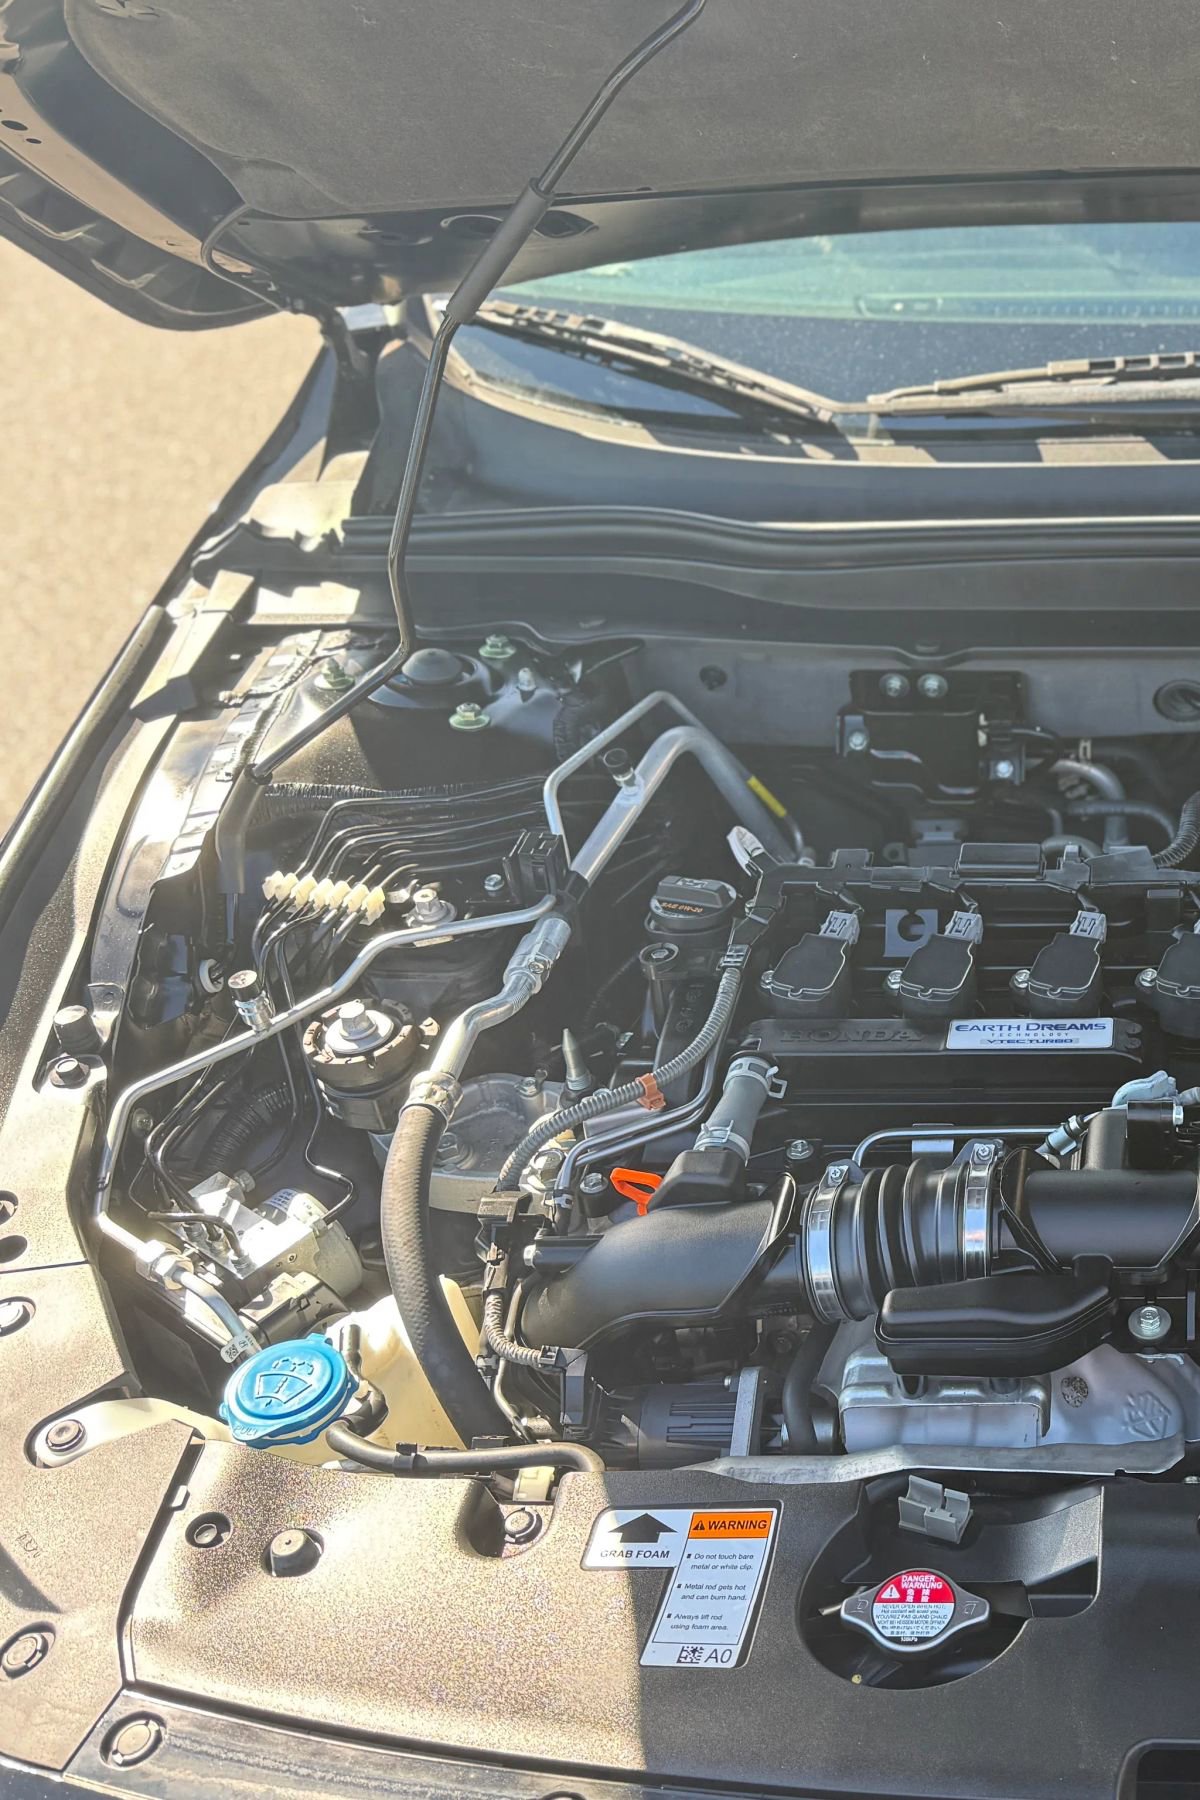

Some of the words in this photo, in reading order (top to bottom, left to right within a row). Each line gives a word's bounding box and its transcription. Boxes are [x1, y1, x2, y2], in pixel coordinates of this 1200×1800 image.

[955, 1024, 1020, 1032] EARTH
[1025, 1022, 1107, 1031] DREAMS
[781, 1029, 923, 1042] HONDA
[708, 1520, 768, 1530] WARNING
[600, 1549, 633, 1558] GRAB
[635, 1549, 670, 1559] FOAM
[673, 1613, 699, 1621] Always
[704, 1648, 733, 1664] A0
